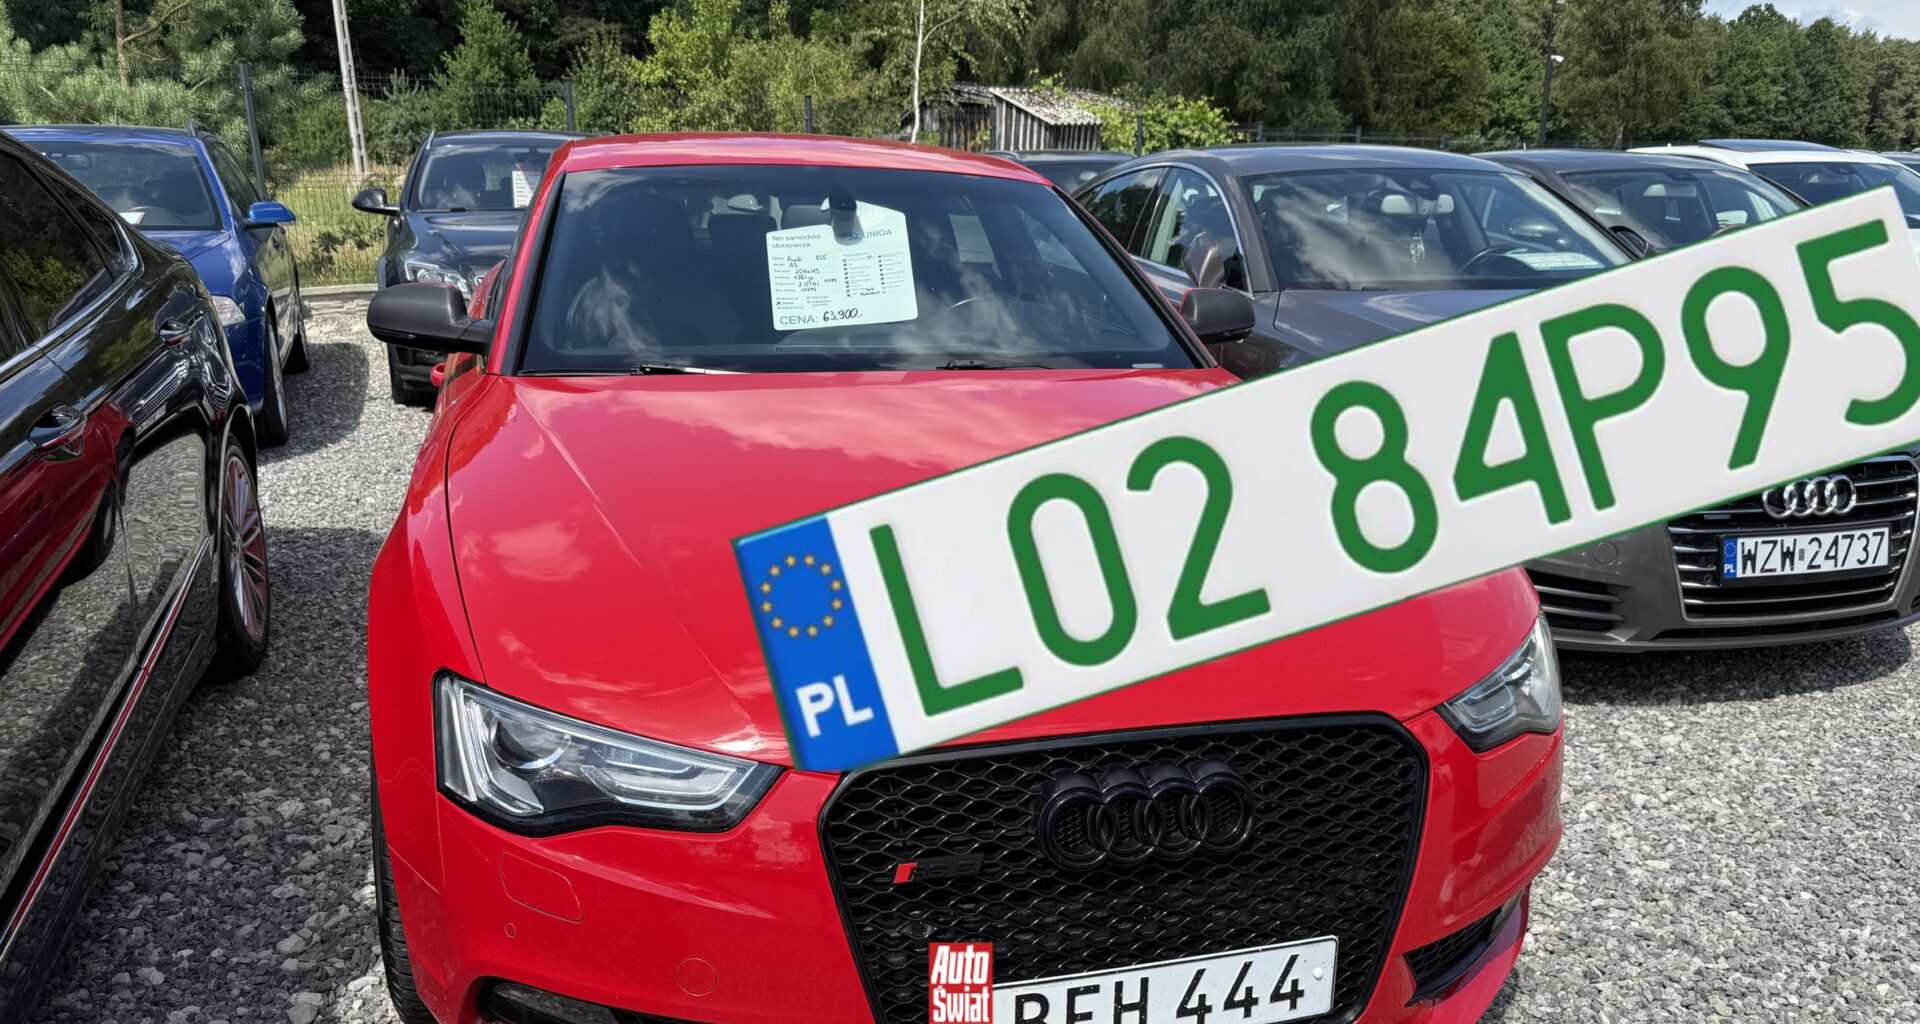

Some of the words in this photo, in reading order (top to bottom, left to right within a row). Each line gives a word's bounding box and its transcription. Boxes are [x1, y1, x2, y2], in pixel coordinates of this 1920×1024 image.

[863, 229, 893, 239] UNIQA
[779, 315, 819, 325] CENA:
[1741, 538, 1797, 575] WZW
[1806, 531, 1886, 570] 24737
[1724, 564, 1736, 573] PL
[1176, 954, 1305, 1024] 444
